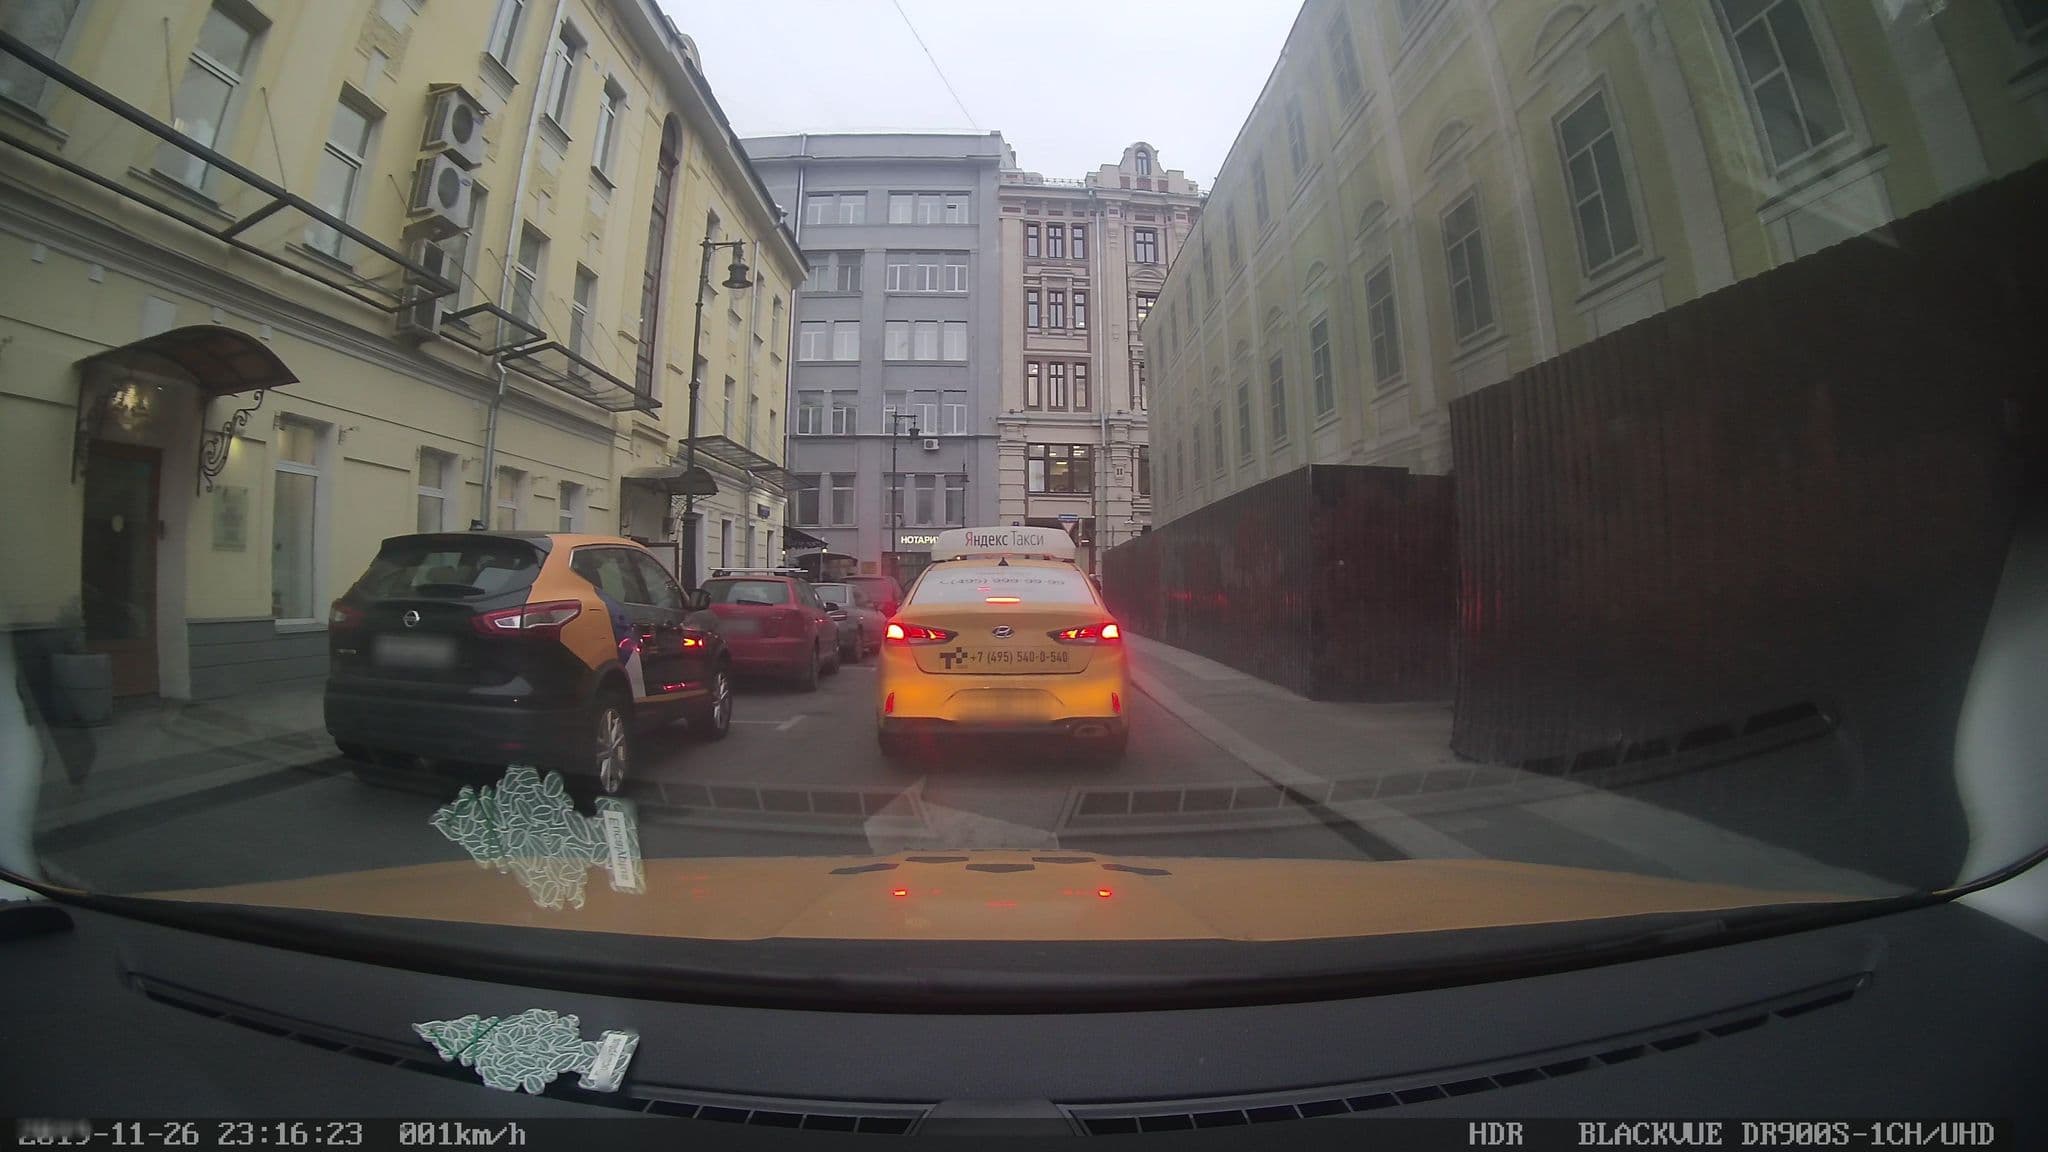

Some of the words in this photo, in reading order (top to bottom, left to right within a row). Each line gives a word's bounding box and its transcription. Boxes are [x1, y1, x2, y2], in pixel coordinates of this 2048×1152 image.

[965, 532, 1008, 547] Яндекс
[1012, 531, 1044, 546] Такси
[970, 651, 983, 663] +7
[987, 651, 1013, 664] (495)
[1017, 651, 1068, 663] 540-0-540
